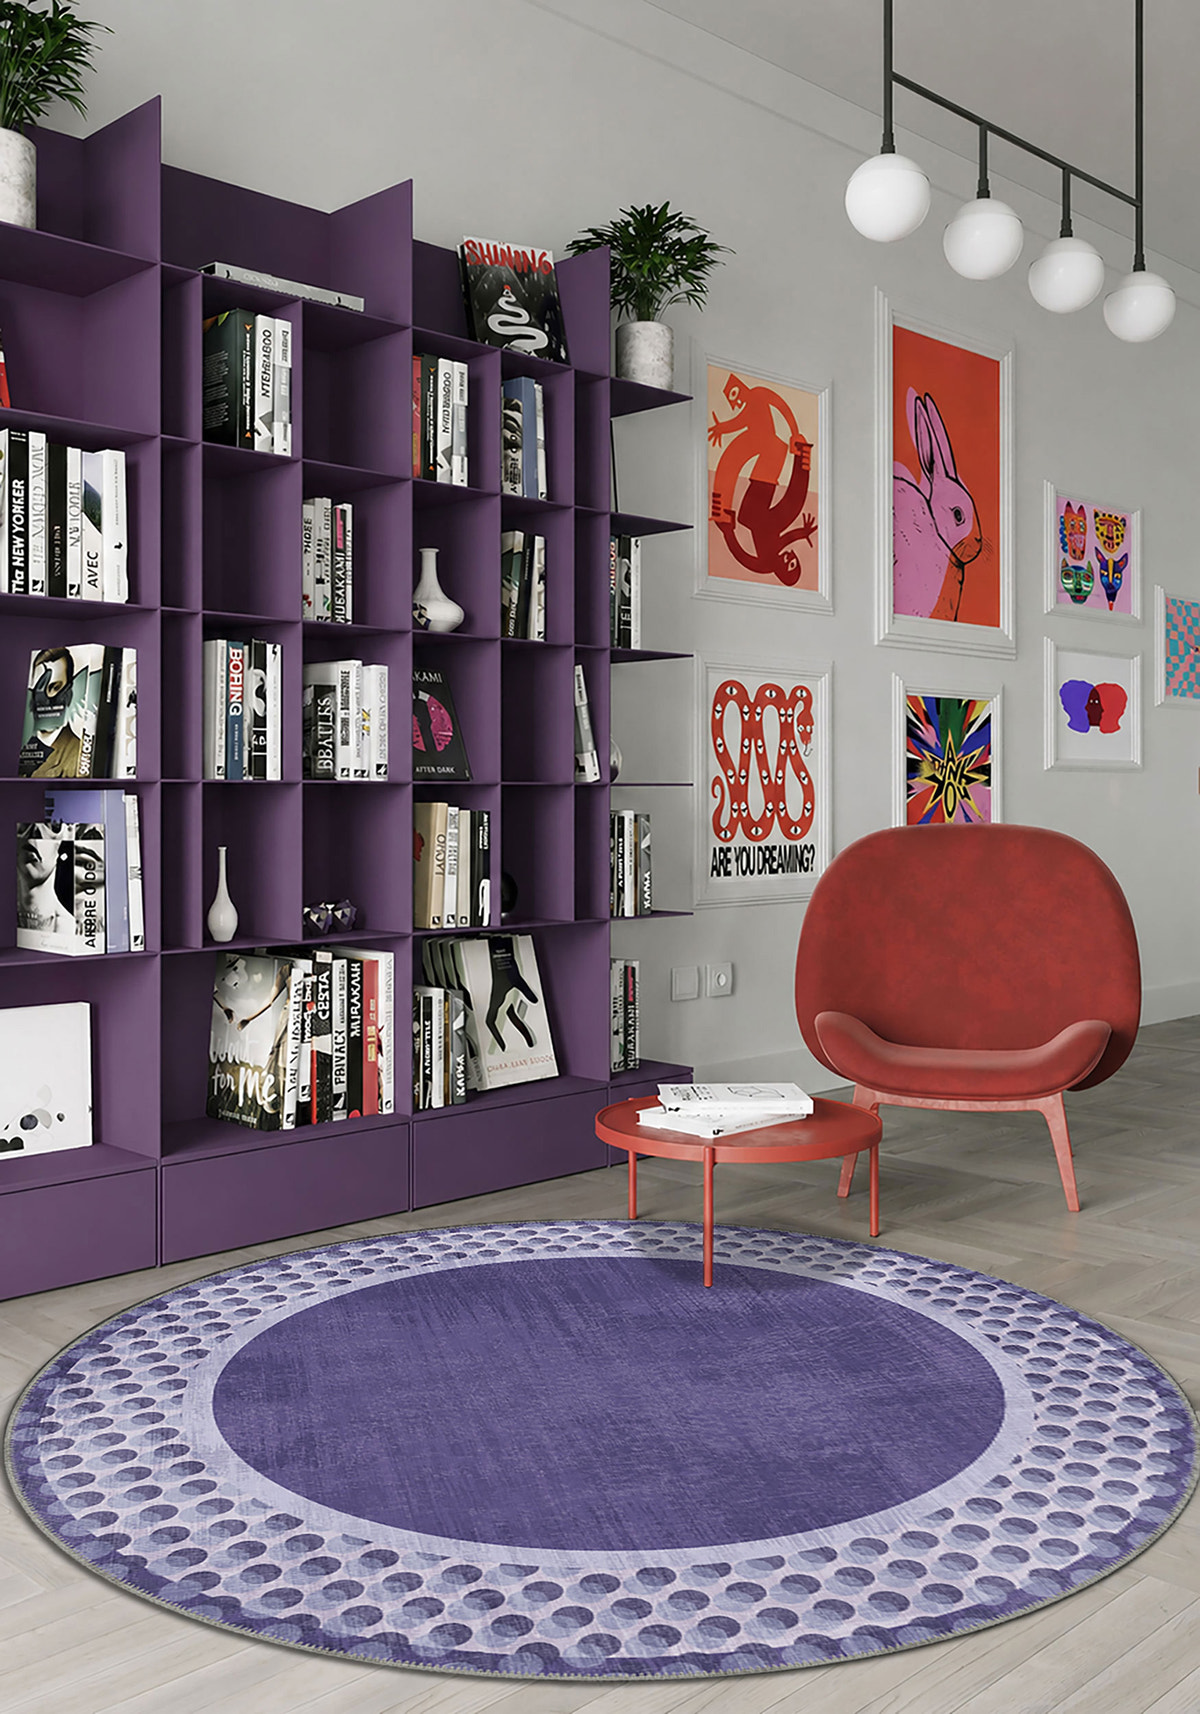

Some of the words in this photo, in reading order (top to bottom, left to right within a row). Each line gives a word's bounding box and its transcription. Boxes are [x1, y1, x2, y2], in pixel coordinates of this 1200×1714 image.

[464, 239, 552, 275] SHINING
[12, 538, 25, 567] NEW
[86, 551, 99, 588] AVEC
[229, 646, 243, 717] BORING
[711, 846, 732, 877] ARE
[734, 845, 756, 876] YOU
[757, 844, 816, 875] DREAMING?
